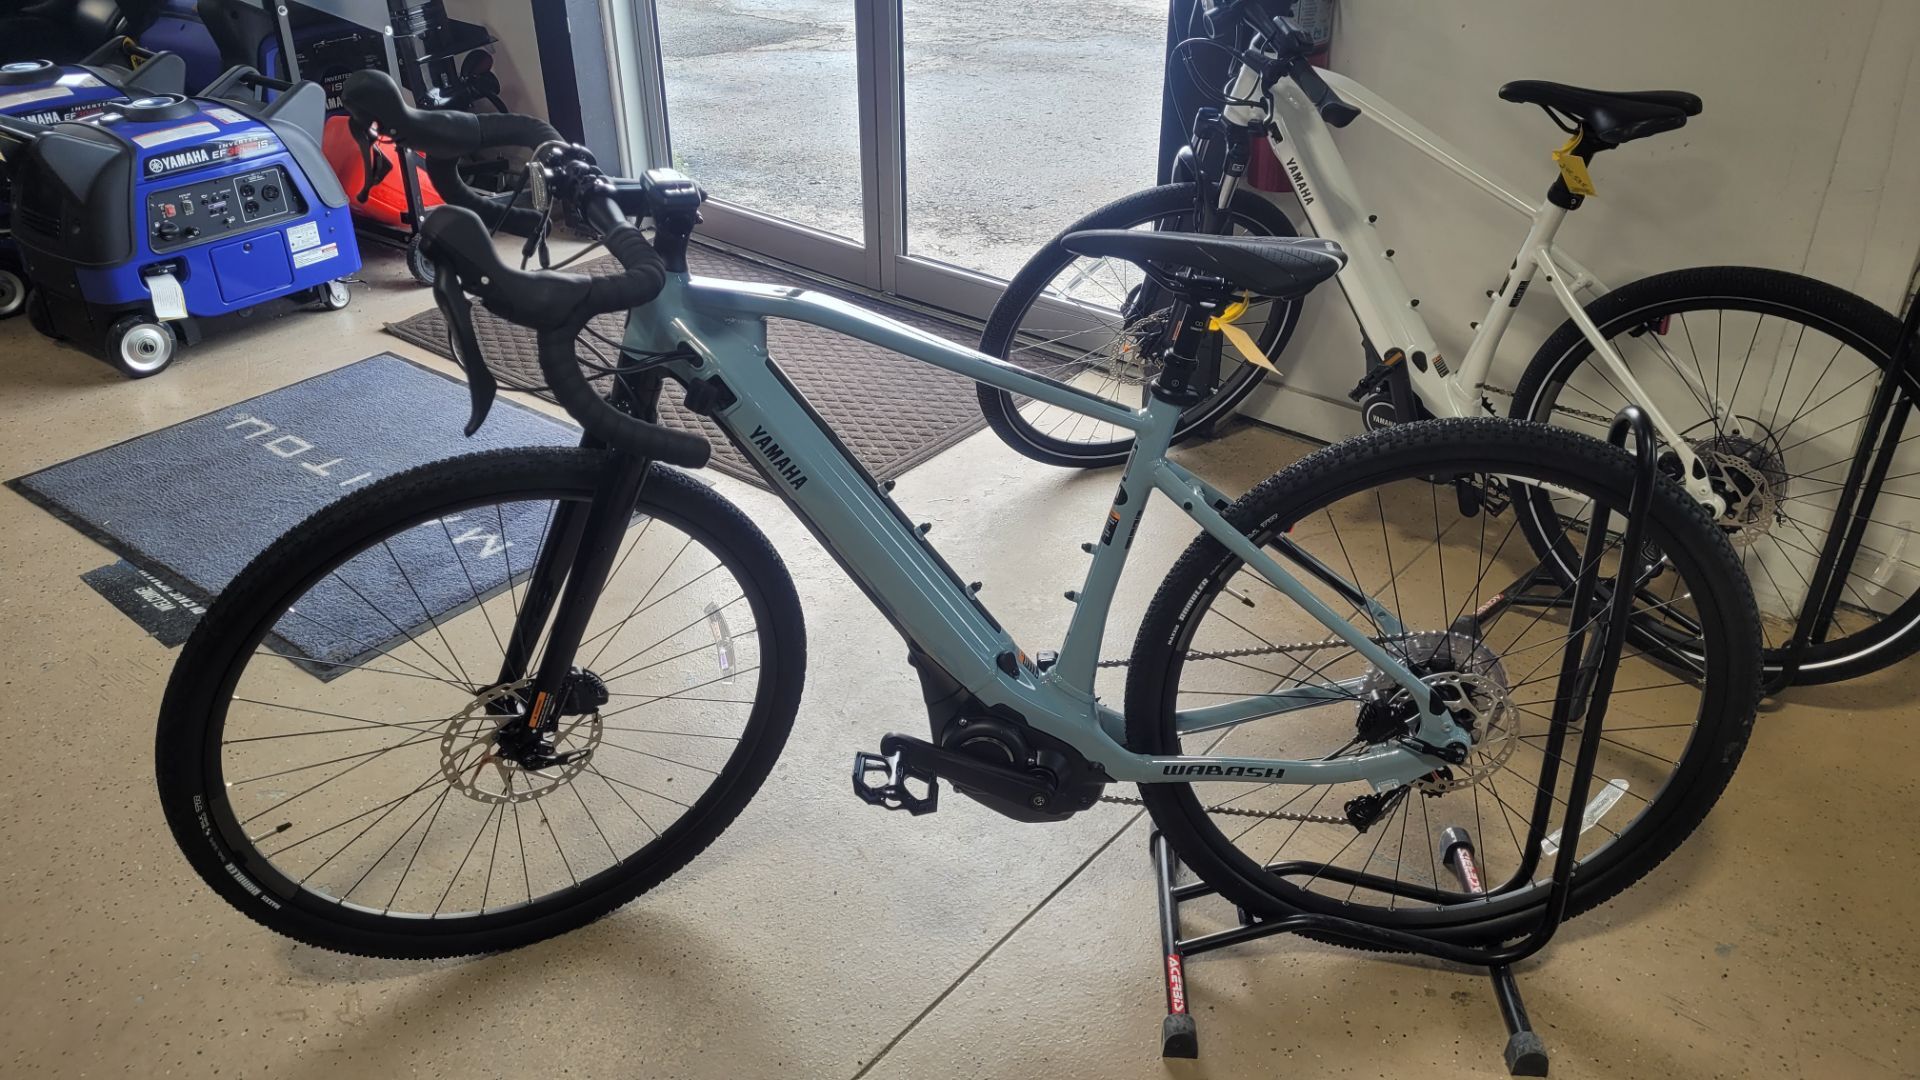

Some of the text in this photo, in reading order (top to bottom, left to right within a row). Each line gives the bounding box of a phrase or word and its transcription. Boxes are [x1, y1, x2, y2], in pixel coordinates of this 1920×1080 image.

[20, 111, 61, 125] MAHA
[162, 148, 210, 170] YAMAHA
[1286, 157, 1315, 206] YAMAHA
[750, 425, 809, 491] YAMAHA
[1162, 765, 1286, 779] WABASH
[1168, 956, 1186, 1012] ACERBIS
